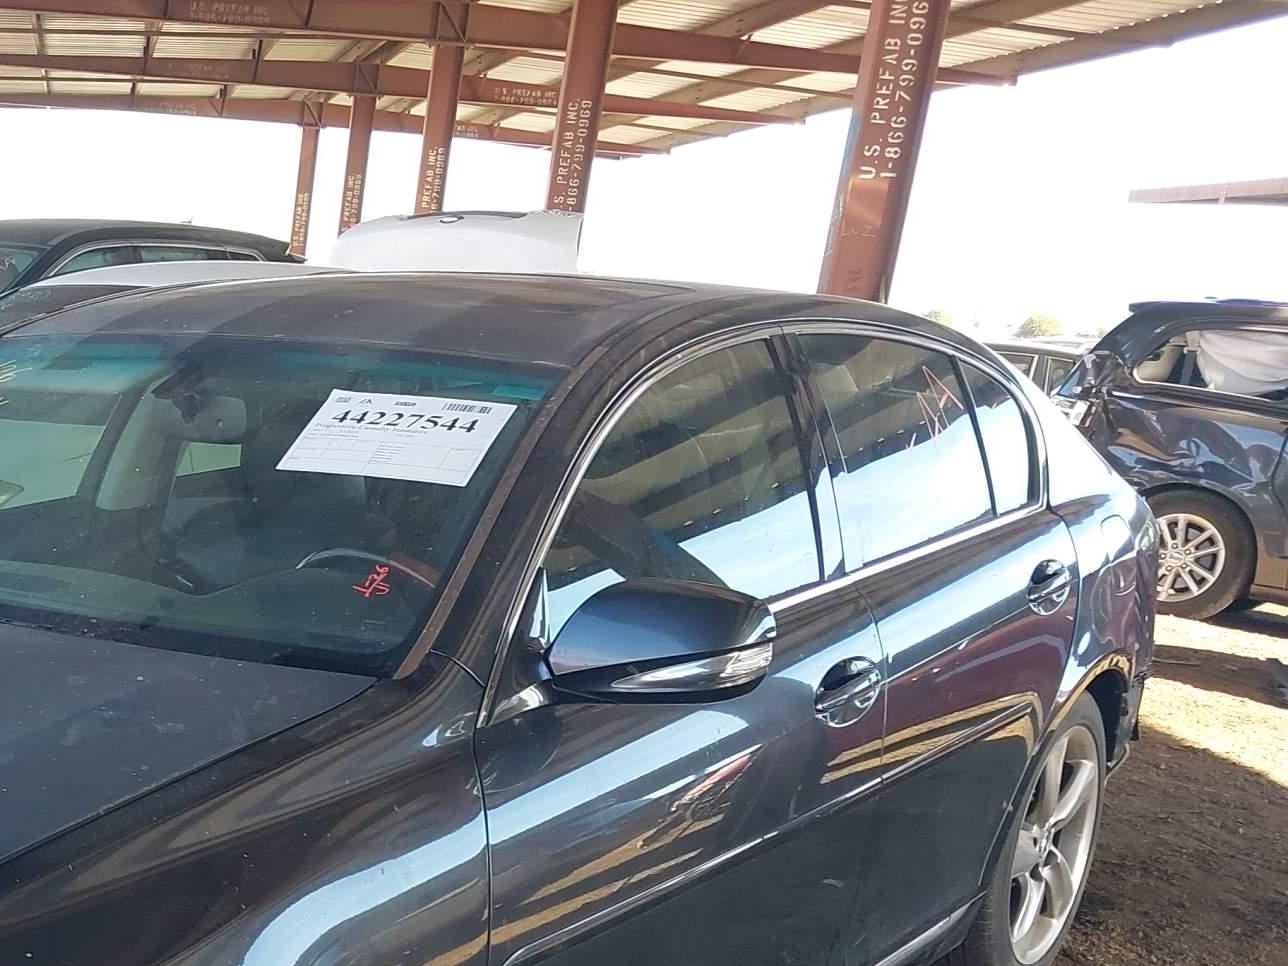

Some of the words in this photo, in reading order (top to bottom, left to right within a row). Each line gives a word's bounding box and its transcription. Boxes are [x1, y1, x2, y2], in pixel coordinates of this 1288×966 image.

[888, 0, 909, 25] IN
[870, 38, 902, 125] PREFAB
[556, 131, 575, 184] PREFAB
[858, 138, 884, 180] U.S.
[331, 408, 480, 434] 44227544
